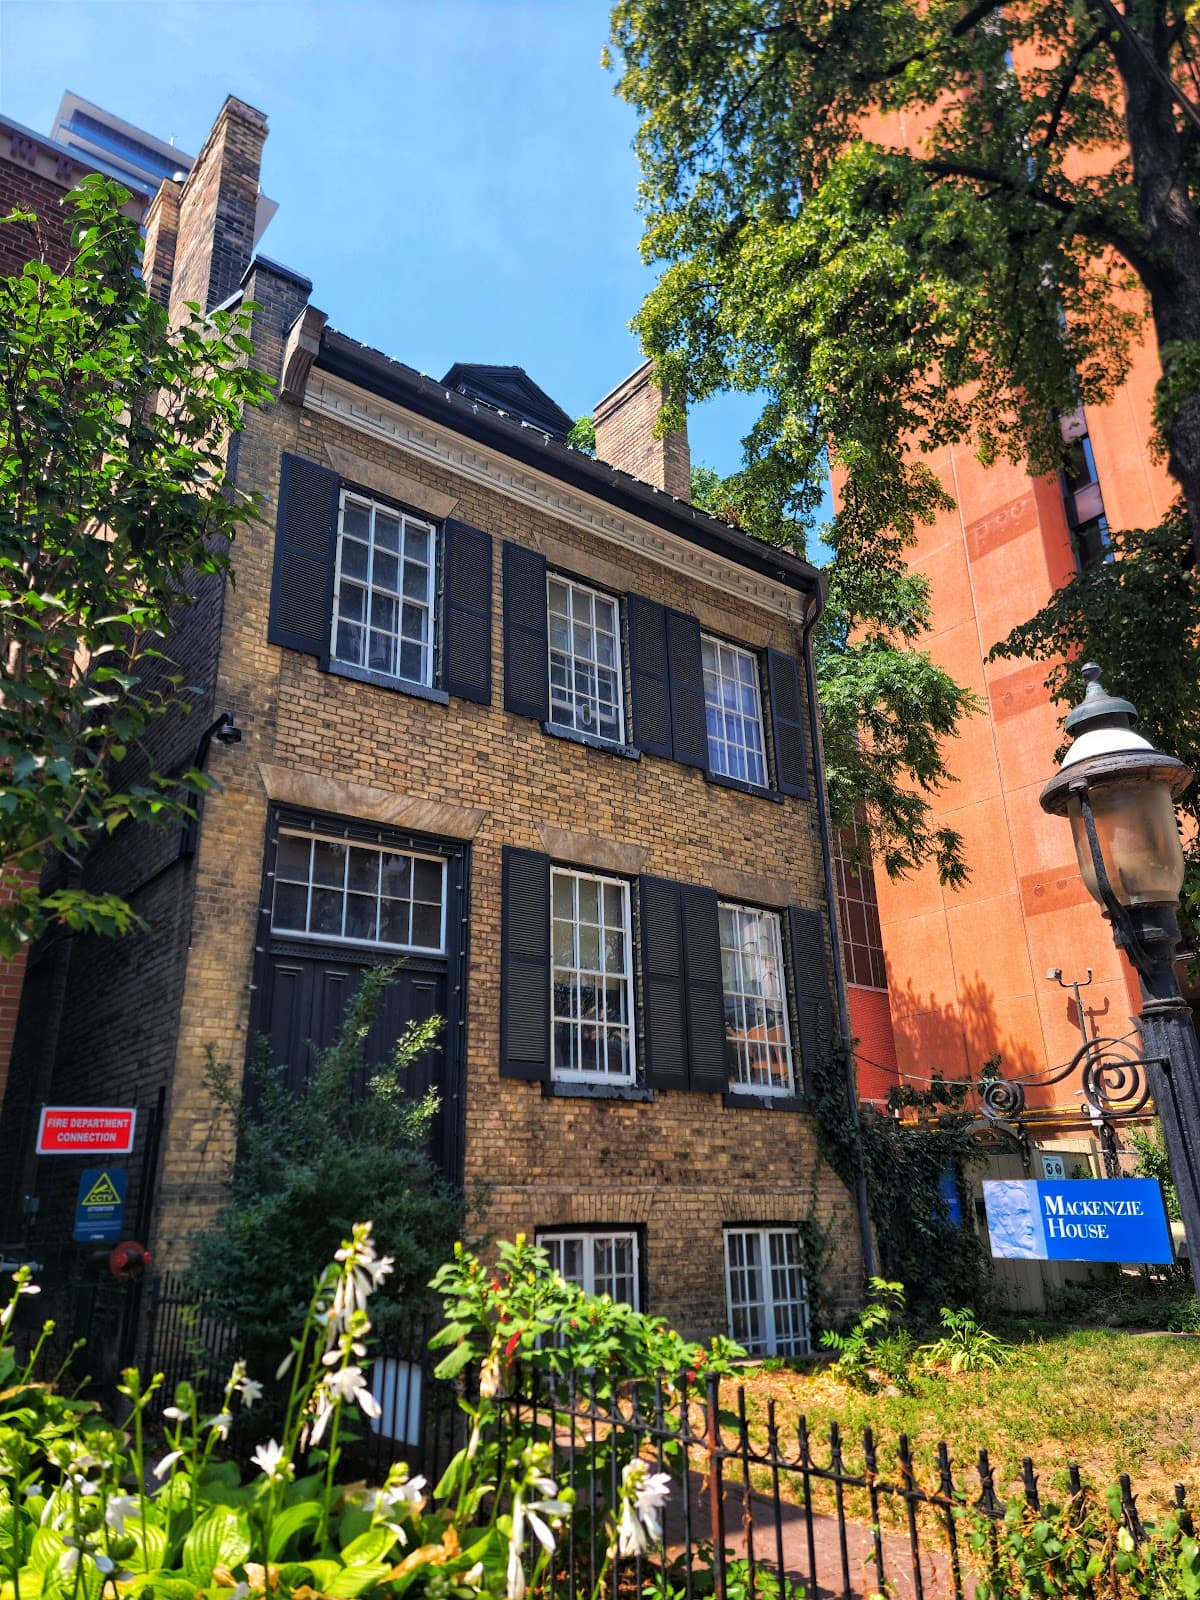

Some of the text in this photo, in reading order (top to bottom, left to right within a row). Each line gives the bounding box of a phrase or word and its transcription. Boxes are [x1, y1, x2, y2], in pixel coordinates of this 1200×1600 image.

[47, 1118, 129, 1128] FIRE DEPARTMENT
[57, 1132, 117, 1142] CONNECTION
[90, 1194, 113, 1202] CCTV
